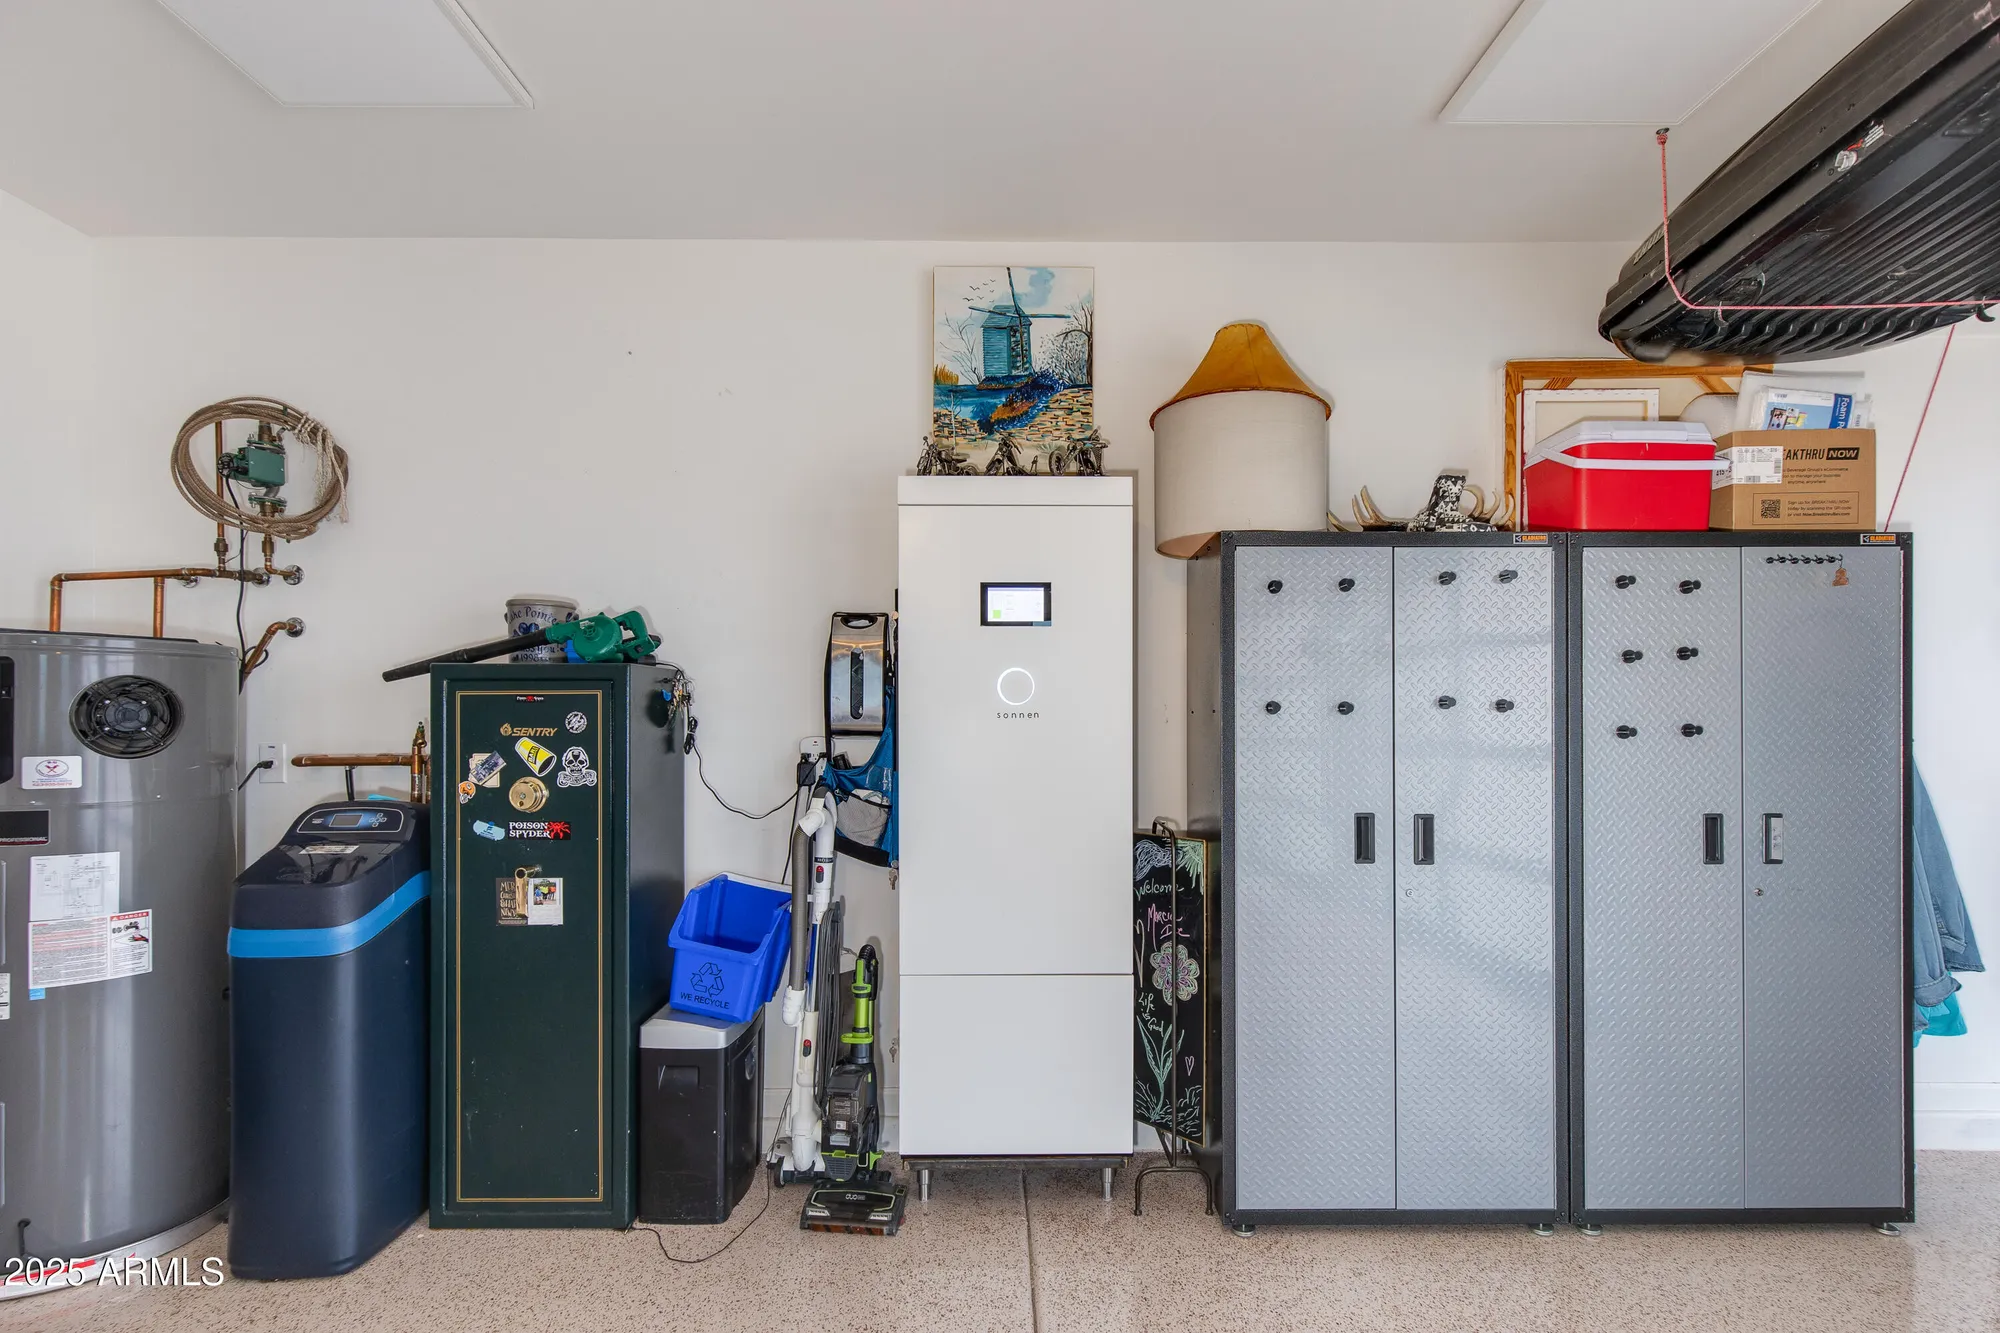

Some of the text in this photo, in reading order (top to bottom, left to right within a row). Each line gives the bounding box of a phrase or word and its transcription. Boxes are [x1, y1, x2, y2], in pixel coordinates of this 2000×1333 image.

[1839, 397, 1850, 420] Foam
[1828, 449, 1858, 458] NOW
[996, 711, 1040, 719] sonnen
[511, 727, 558, 737] SENTRY
[508, 821, 549, 830] POISON
[508, 829, 552, 839] SPYDER
[680, 991, 730, 1010] WE RECYCLE
